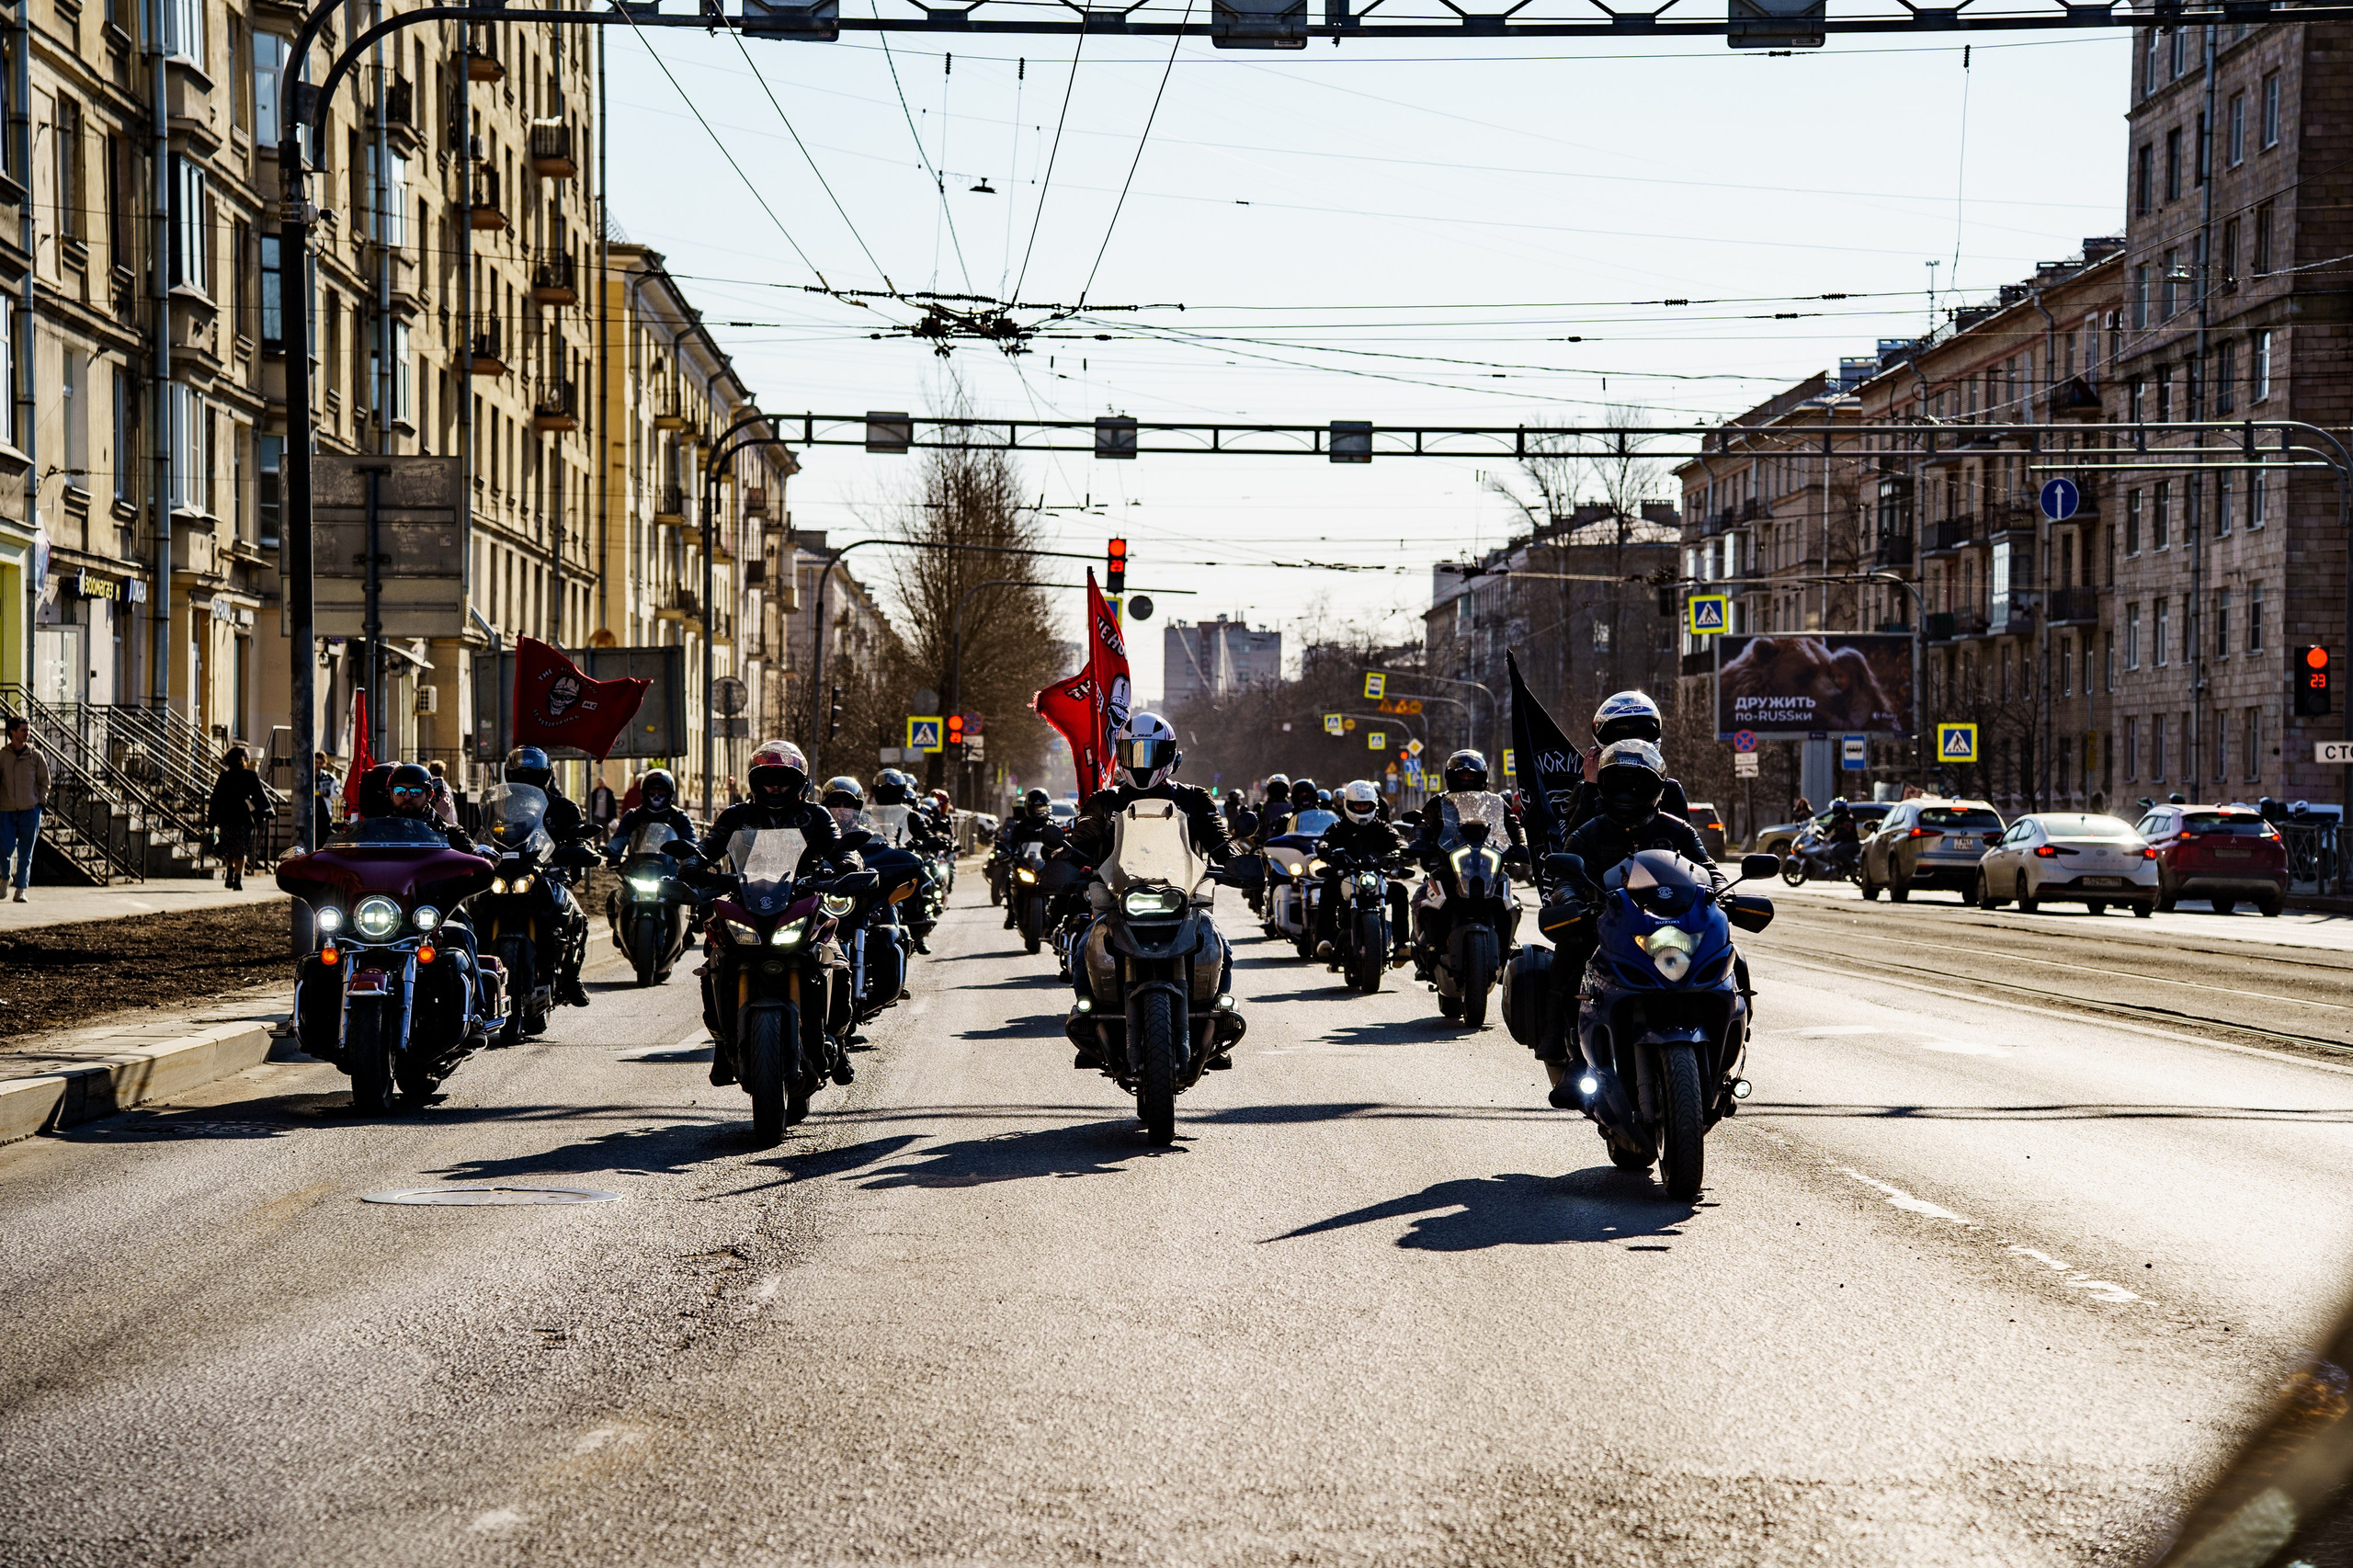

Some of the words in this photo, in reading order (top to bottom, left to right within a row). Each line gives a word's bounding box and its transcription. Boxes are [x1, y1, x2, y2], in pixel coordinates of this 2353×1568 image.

[1109, 559, 1124, 573] 23
[538, 668, 553, 681] THE
[2310, 673, 2326, 688] 23
[1734, 696, 1816, 710] ДРУЖИТЬ
[1735, 710, 1813, 722] по-RUSSки
[1535, 750, 1584, 775] NORM
